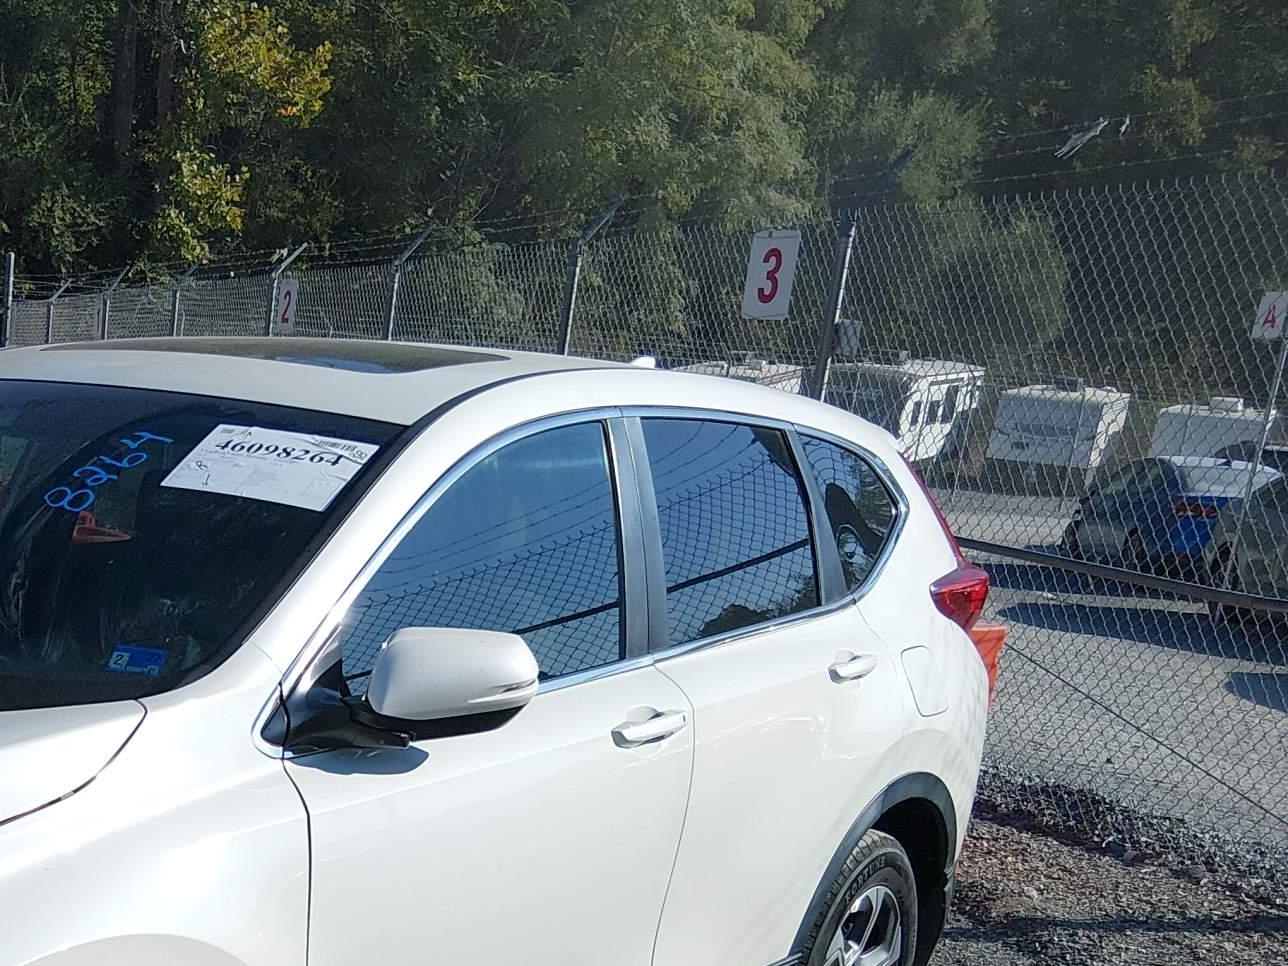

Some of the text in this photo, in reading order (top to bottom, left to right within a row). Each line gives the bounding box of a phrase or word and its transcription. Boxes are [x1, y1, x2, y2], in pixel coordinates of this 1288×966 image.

[758, 247, 783, 304] 3
[280, 290, 292, 324] 2
[1262, 304, 1277, 329] 4
[214, 439, 344, 466] 46098264
[44, 431, 175, 512] 8264
